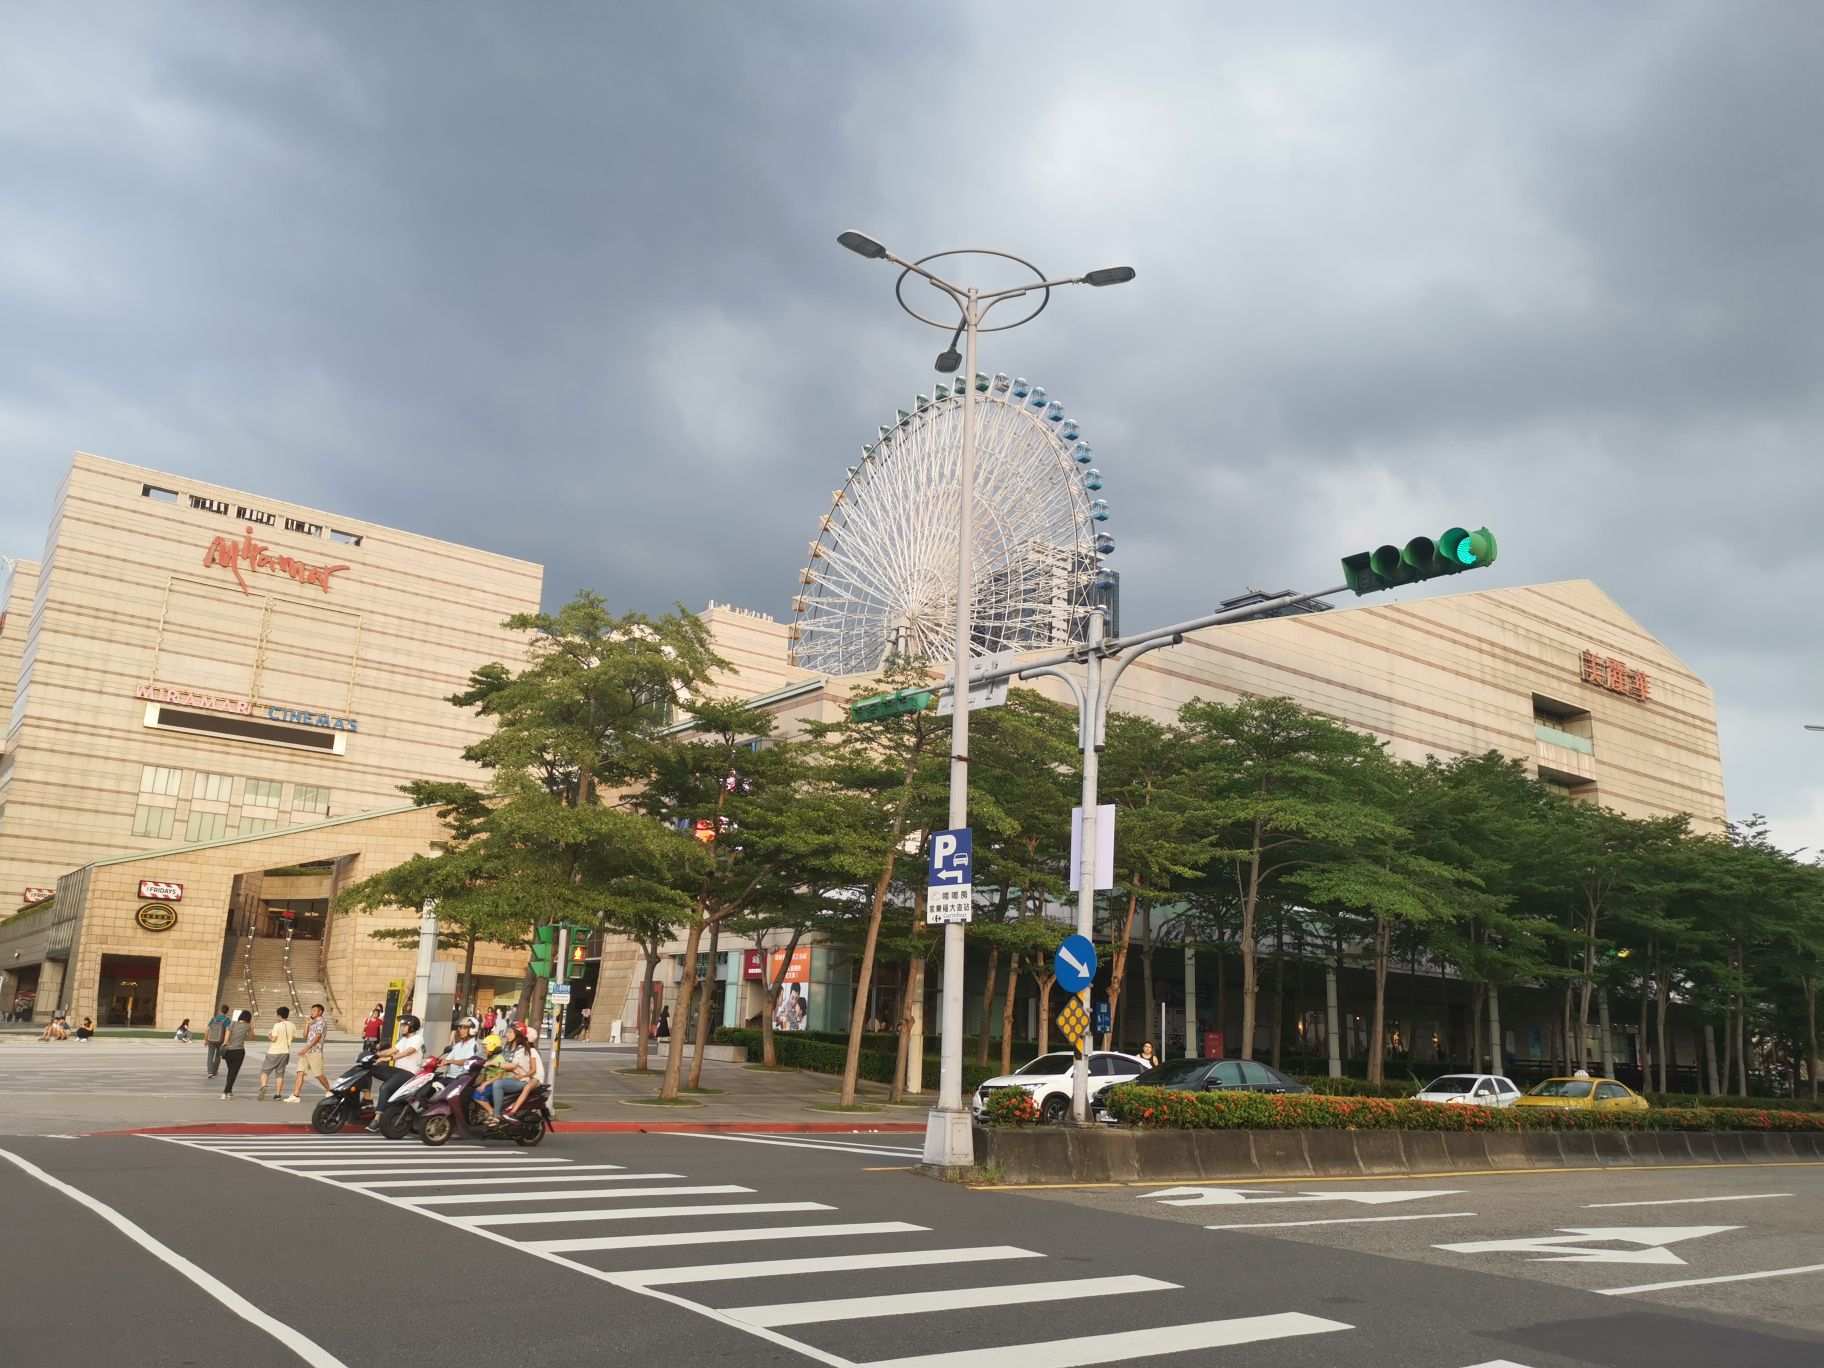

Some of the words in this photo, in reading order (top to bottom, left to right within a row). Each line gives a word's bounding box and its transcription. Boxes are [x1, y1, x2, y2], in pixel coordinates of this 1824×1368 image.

[1582, 650, 1650, 702] 美麗華
[136, 685, 252, 715] MIRAMAR
[268, 705, 358, 732] CINEMAS
[934, 834, 957, 869] P
